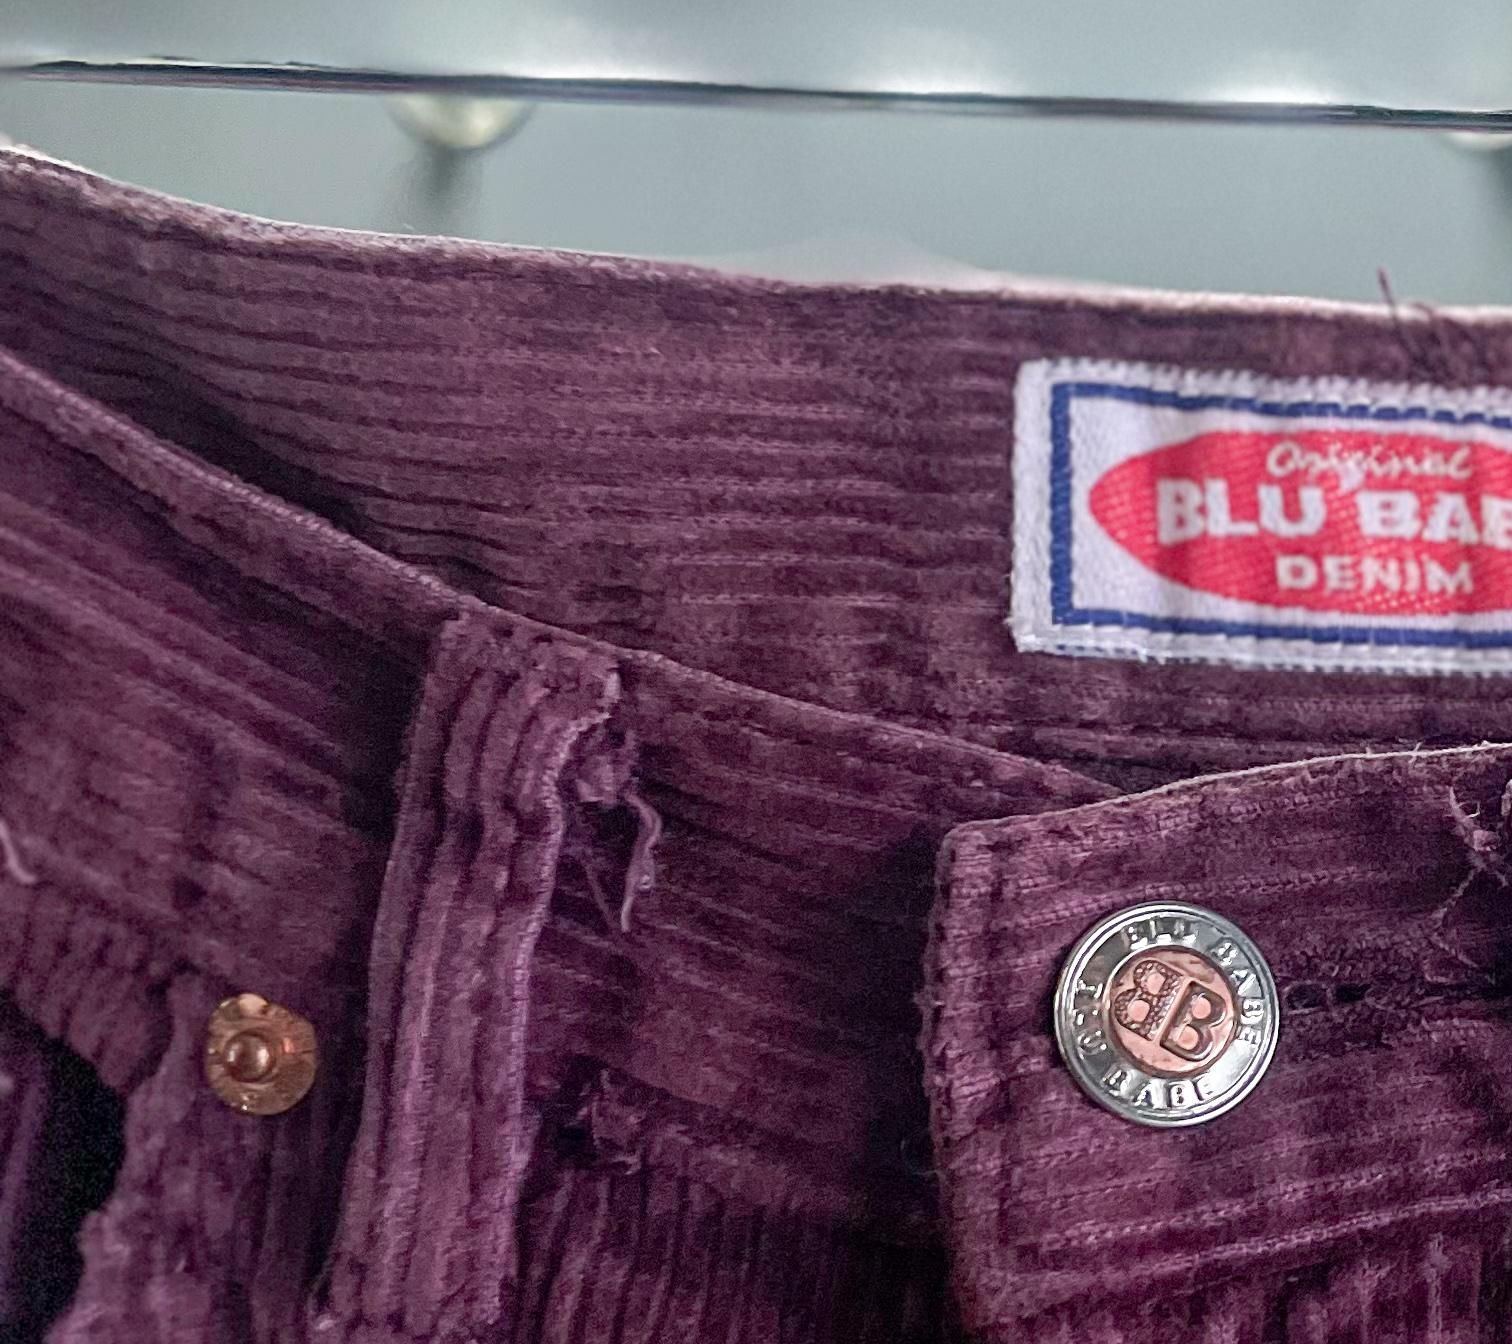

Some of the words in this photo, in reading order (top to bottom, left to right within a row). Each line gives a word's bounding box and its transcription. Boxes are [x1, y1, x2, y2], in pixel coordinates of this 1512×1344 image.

[1265, 440, 1474, 492] Original
[1155, 477, 1328, 547] BLU
[1274, 553, 1475, 595] DENIM
